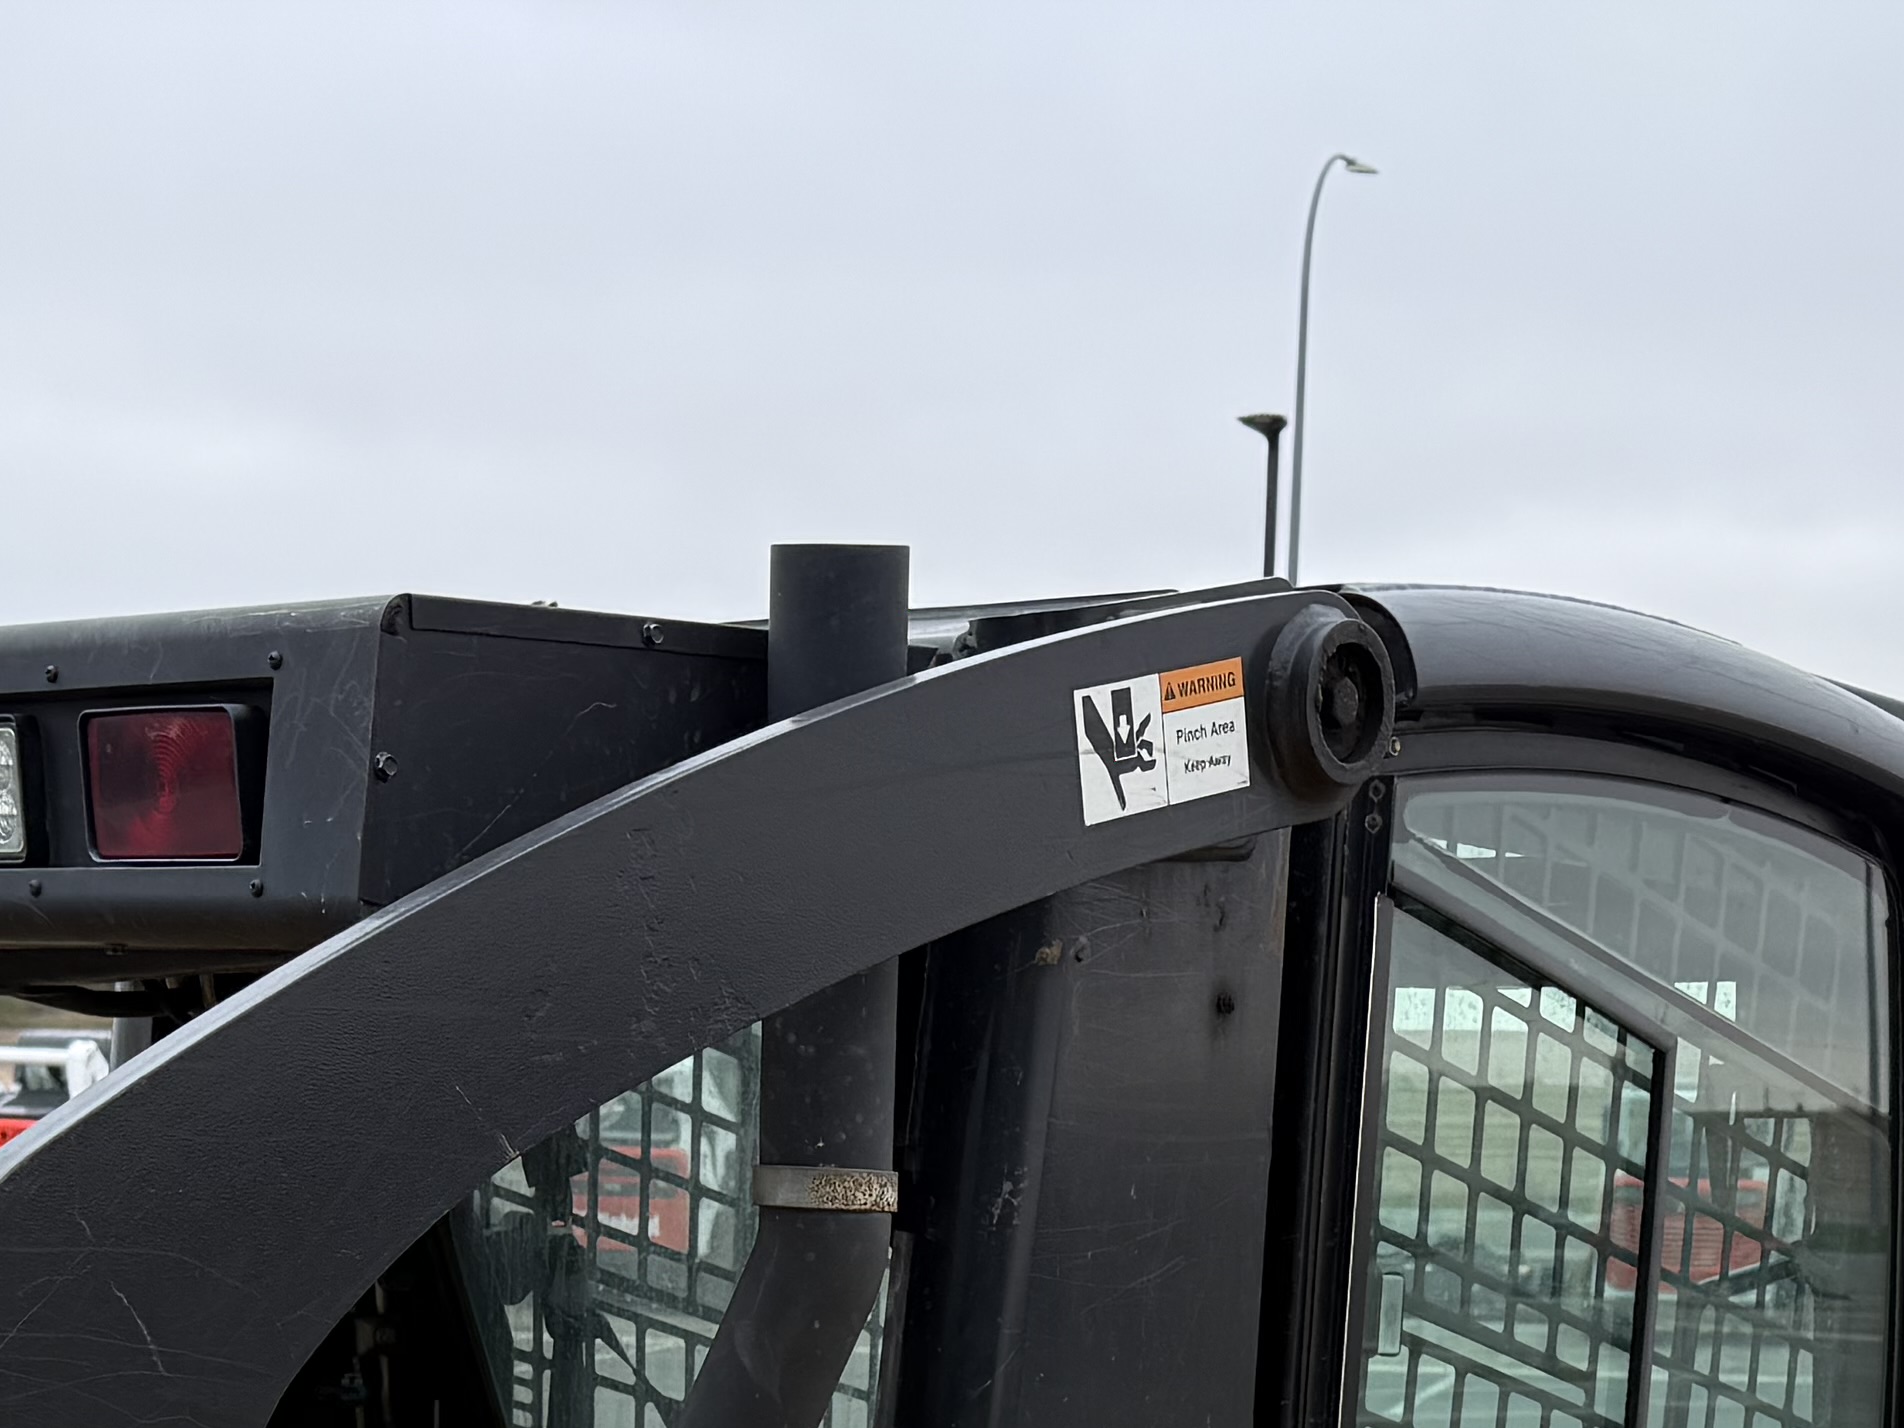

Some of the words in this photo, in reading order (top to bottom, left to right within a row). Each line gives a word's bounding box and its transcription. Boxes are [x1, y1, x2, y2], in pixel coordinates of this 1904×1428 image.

[1177, 672, 1236, 698] WARNING
[1176, 724, 1207, 745] Pinch
[1210, 720, 1235, 737] Area
[1184, 758, 1207, 774] Keep
